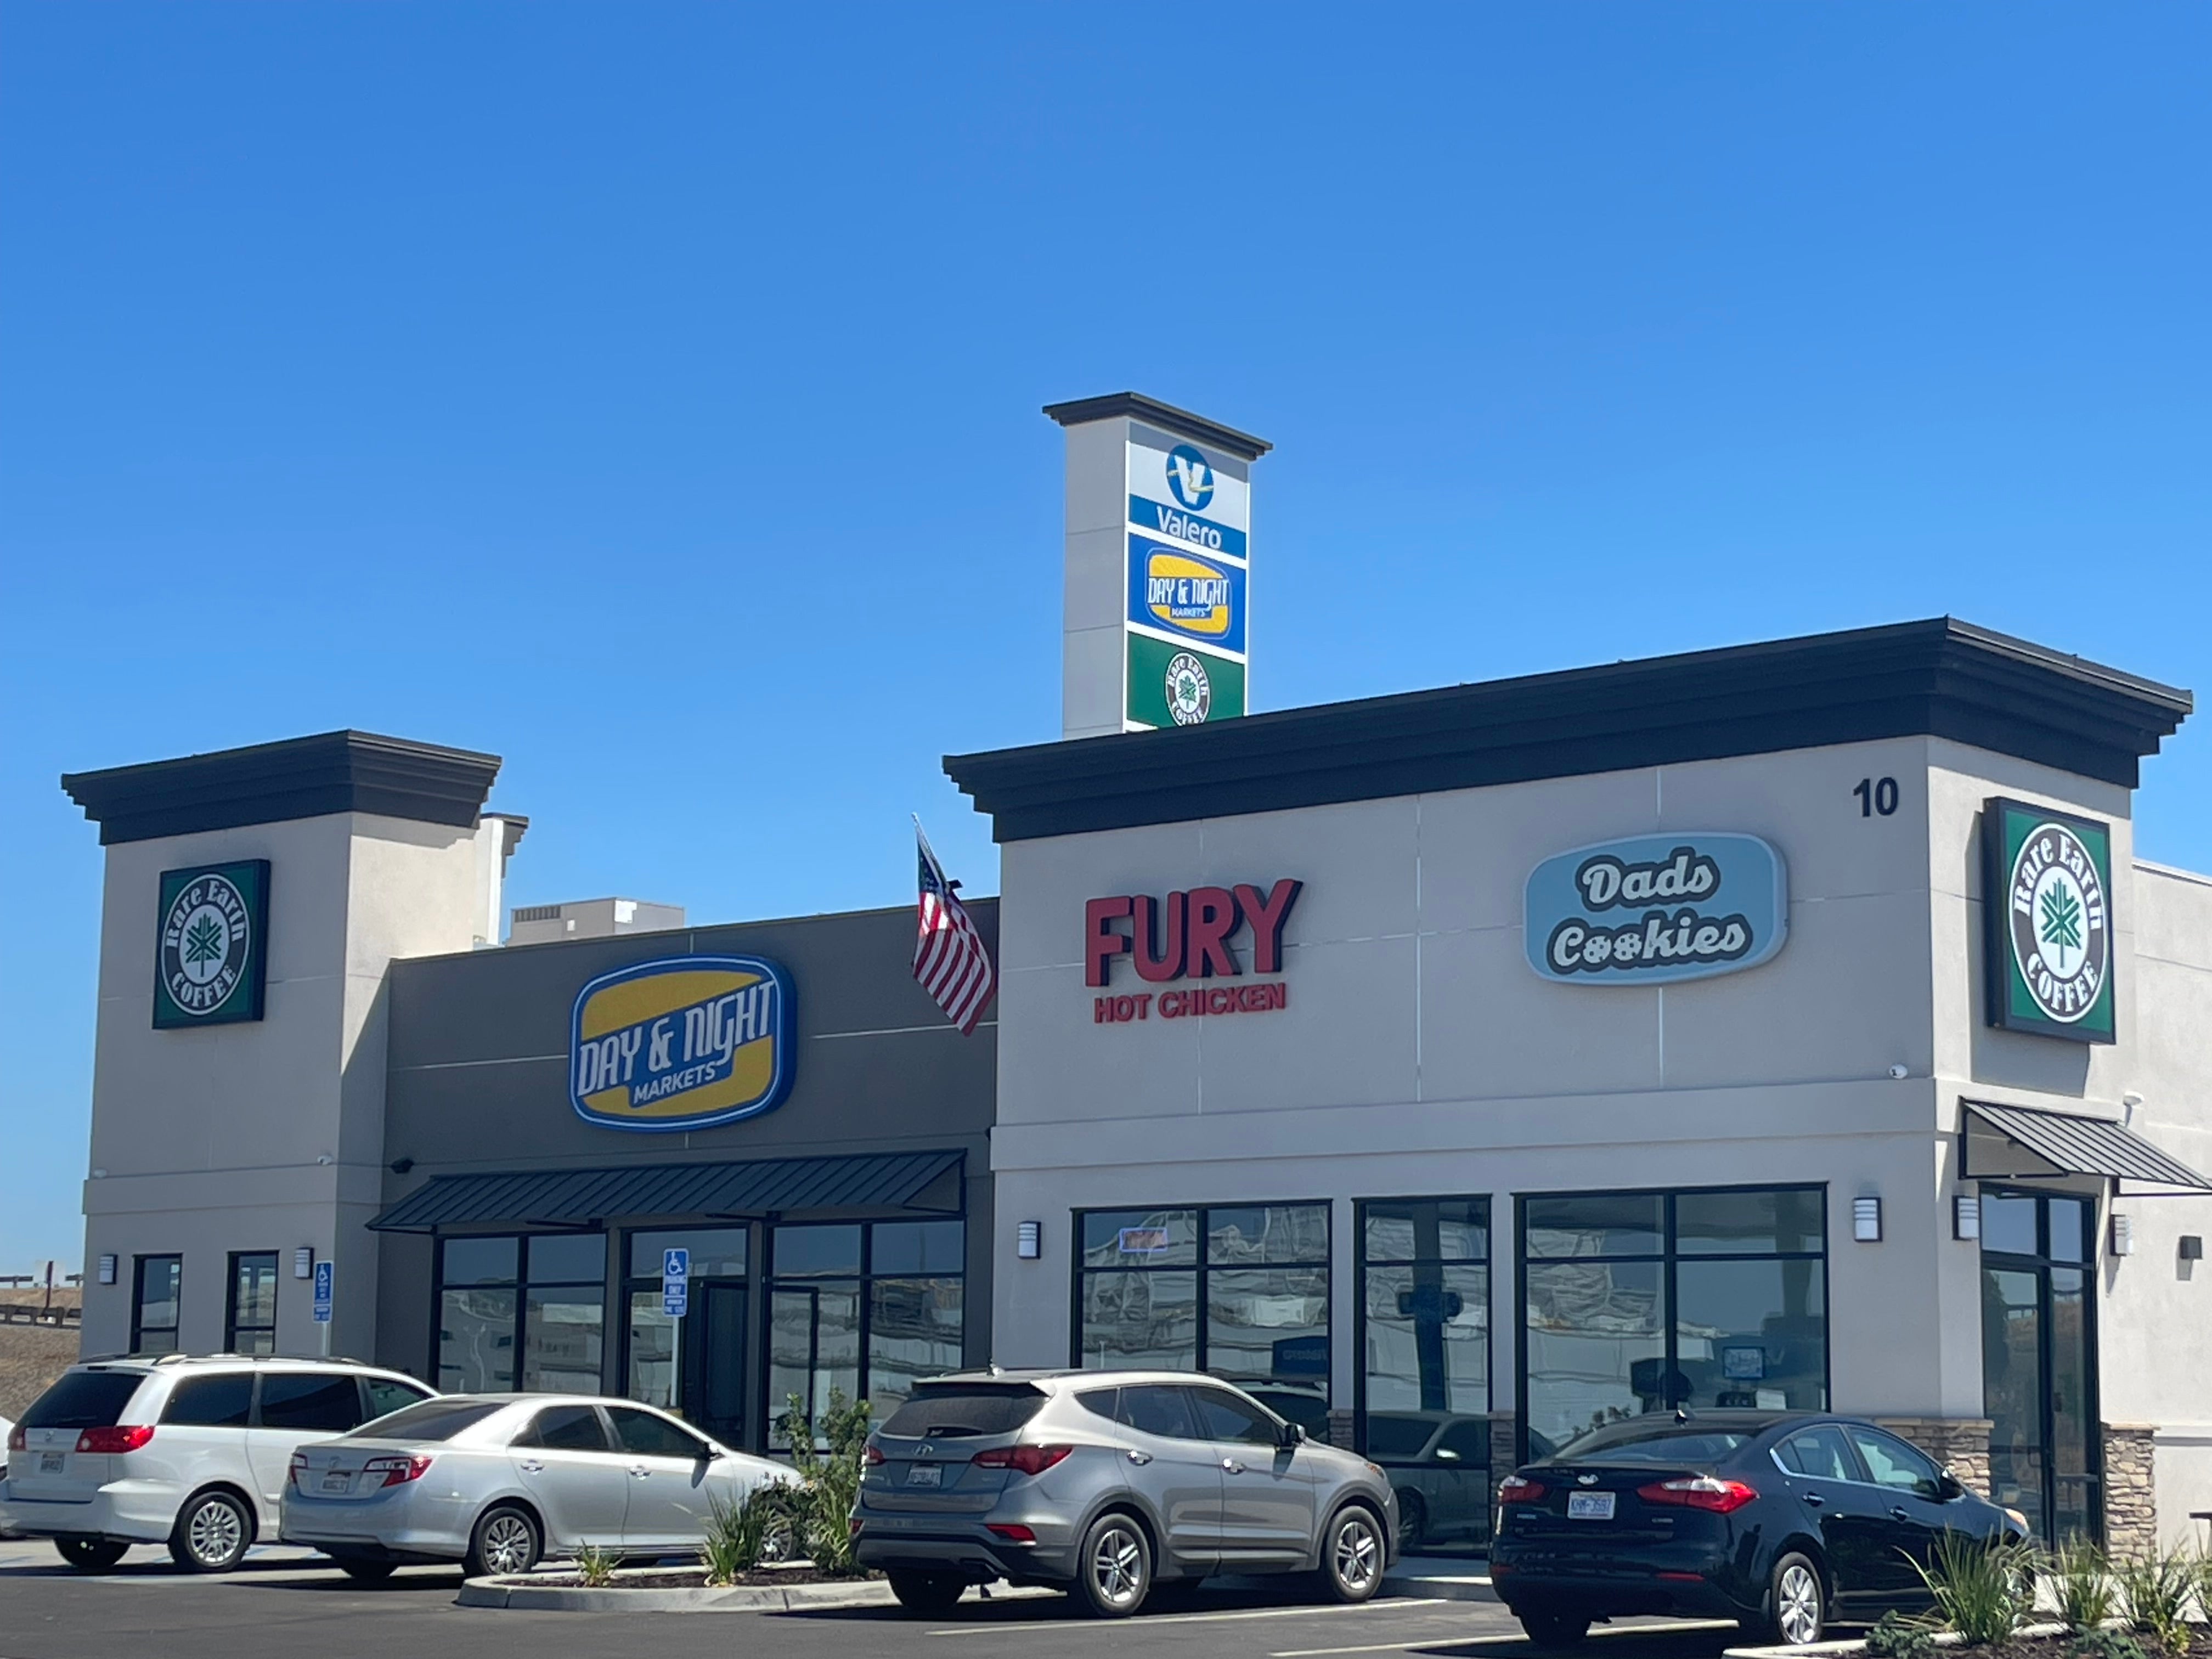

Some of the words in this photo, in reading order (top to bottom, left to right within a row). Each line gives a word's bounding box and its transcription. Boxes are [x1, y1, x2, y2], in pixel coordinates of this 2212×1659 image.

[1156, 505, 1222, 550] Valero
[1147, 577, 1176, 604] DAY
[1177, 578, 1188, 605] &
[1172, 607, 1206, 617] MARKETS
[1167, 657, 1186, 688] Rare
[1187, 657, 1209, 697] Earth
[1853, 777, 1899, 817] 10
[1580, 854, 1715, 906] Dads
[2013, 835, 2054, 917] Rare
[2058, 833, 2103, 930] Earth
[166, 886, 202, 948] Rare
[206, 879, 245, 942] Earth
[1085, 878, 1304, 988] FURY
[1551, 913, 1748, 969] Cookies
[171, 964, 236, 1008] COFFEE
[1094, 994, 1152, 1024] HOT
[1158, 983, 1286, 1018] CHICKEN
[2027, 952, 2099, 1013] COFFEE
[577, 1026, 643, 1098] DAY
[648, 1015, 675, 1073] &
[633, 1061, 716, 1105] MARKETS
